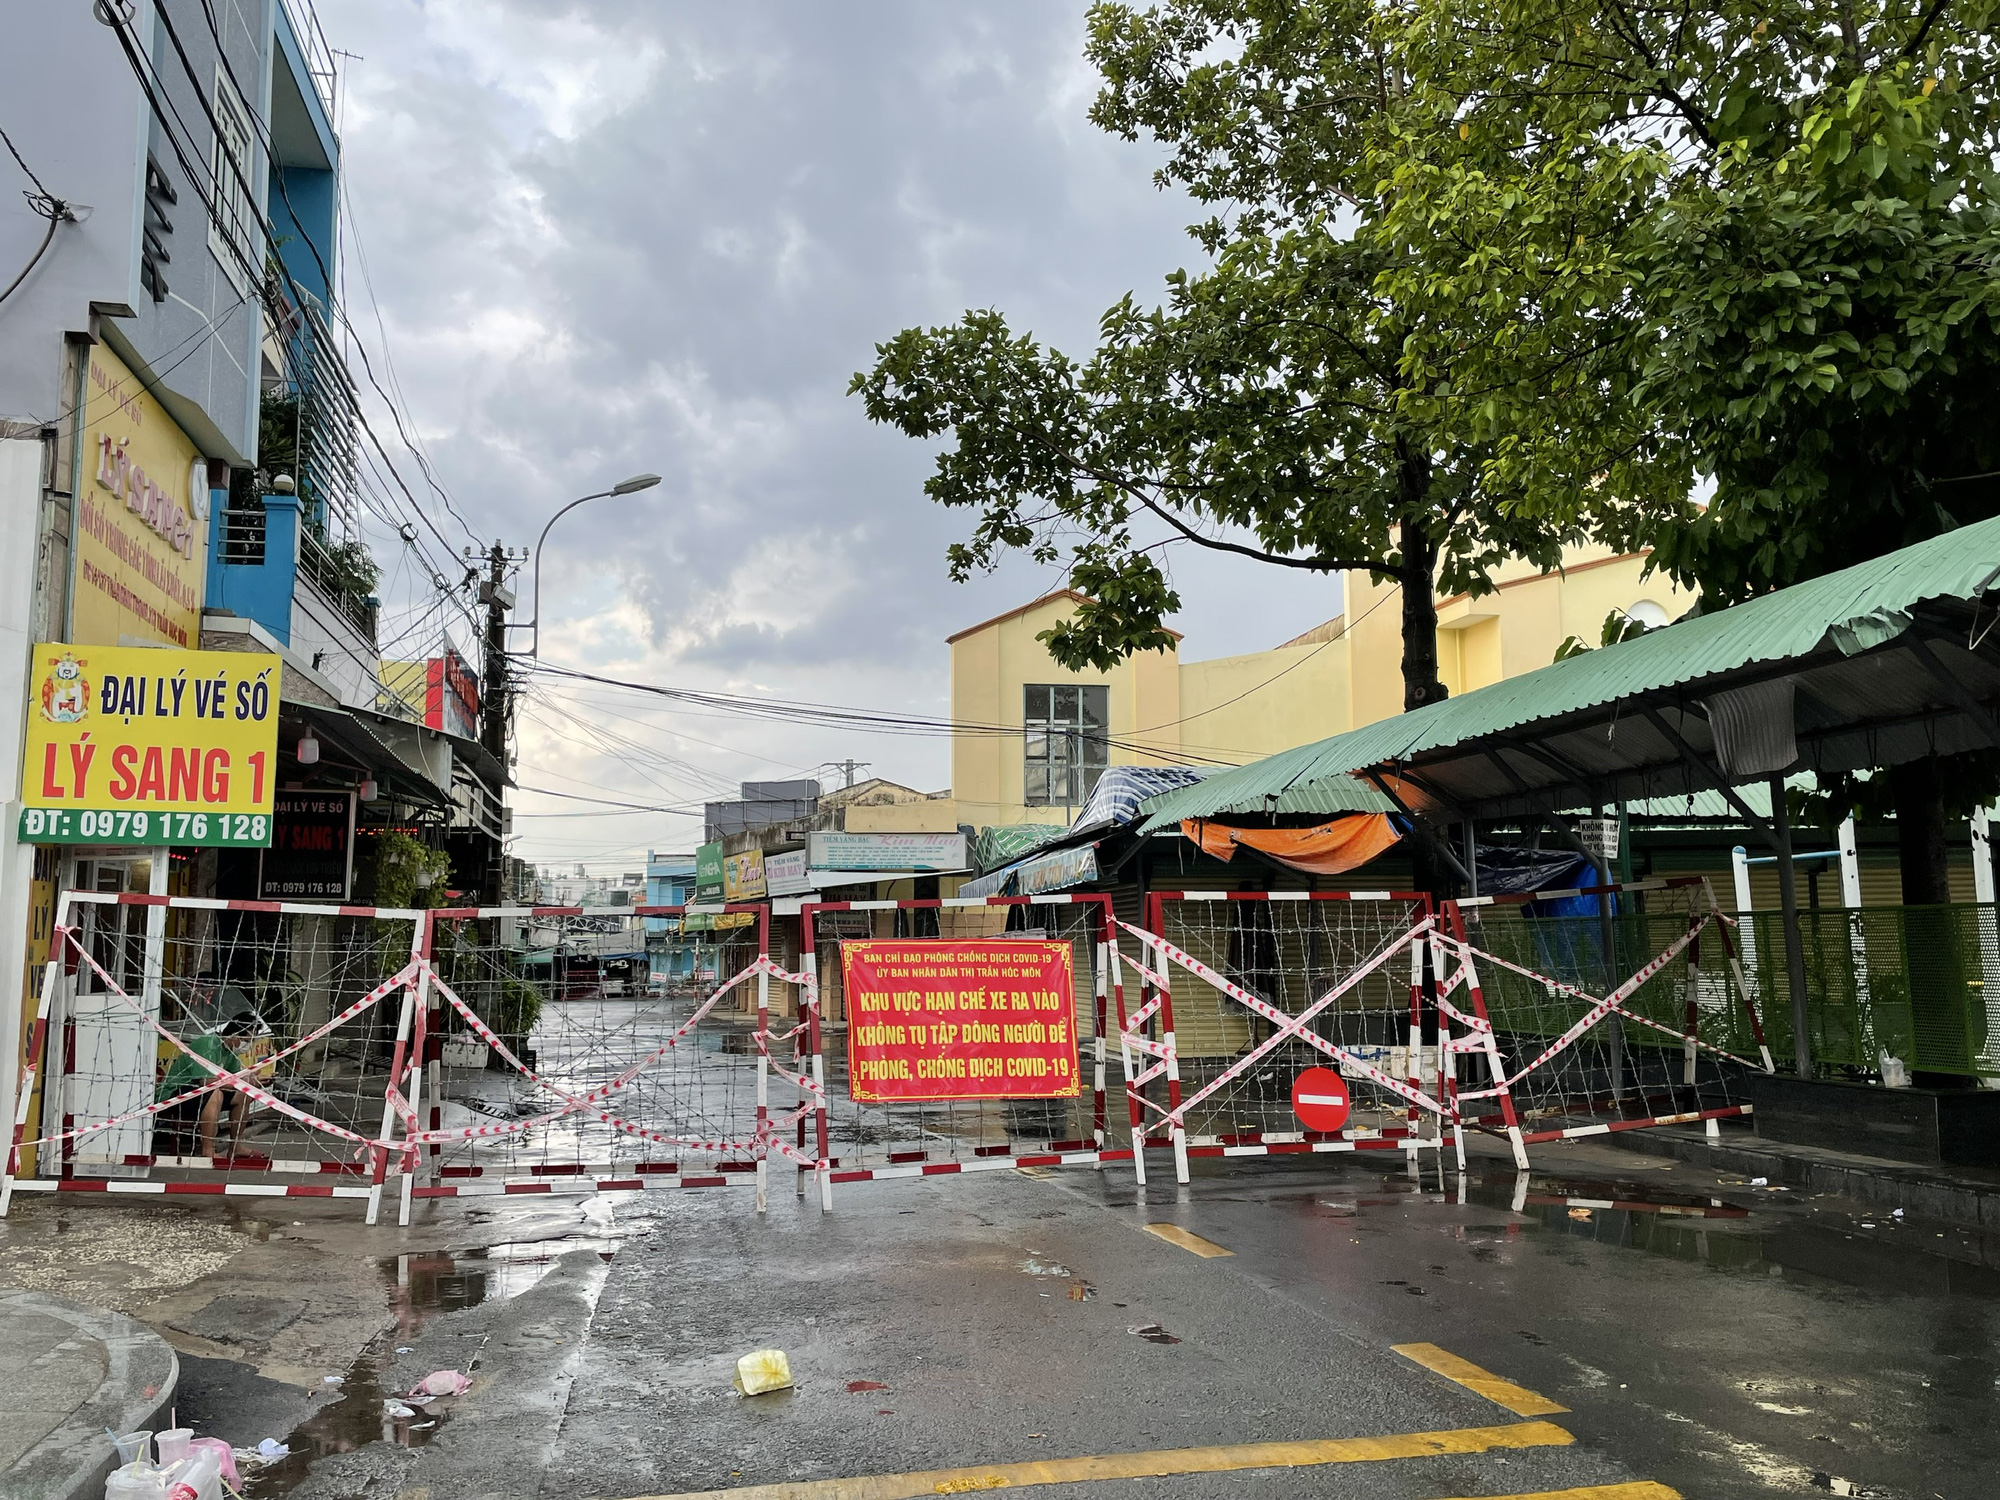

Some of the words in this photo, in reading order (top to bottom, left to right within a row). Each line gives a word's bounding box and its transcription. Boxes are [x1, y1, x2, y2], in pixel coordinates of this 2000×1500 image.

[97, 432, 130, 500] LÝ
[126, 464, 186, 552] SANG
[100, 675, 146, 725] ĐẠI
[155, 669, 188, 718] LÝ
[195, 671, 226, 720] VÉ
[235, 668, 273, 721] SỐ
[42, 732, 96, 799] LÝ
[109, 744, 231, 804] SANG
[248, 751, 266, 804] 1
[294, 799, 308, 813] LÝ
[311, 799, 326, 813] VÉ
[328, 798, 344, 814] SỐ
[25, 809, 70, 837] ĐT:
[80, 811, 149, 838] 0979
[159, 812, 208, 840] 176
[218, 814, 267, 841] 128
[292, 825, 332, 851] SANG
[840, 836, 857, 844] VÀNG
[34, 847, 53, 891] ĐẠI
[786, 855, 800, 864] VÀNG
[788, 864, 802, 876] MAY
[264, 881, 281, 893] ĐT:
[282, 881, 305, 894] 0979
[307, 882, 324, 894] 176
[326, 882, 342, 894] 128
[34, 898, 48, 940] LÝ
[864, 954, 882, 963] BAN
[885, 951, 900, 963] CHỈ
[903, 954, 921, 966] ĐẠO
[924, 951, 954, 963] PHÒNG
[957, 950, 987, 963] CHỐNG
[990, 953, 1011, 965] DỊCH
[1013, 954, 1051, 963] COVID-19
[877, 967, 889, 978] ỦY
[891, 969, 909, 978] BAN
[912, 967, 937, 978] NHÂN
[940, 967, 958, 978] DÂN
[961, 968, 974, 979] THỊ
[977, 966, 999, 978] TRẤN
[1002, 966, 1019, 978] HÓC
[1022, 966, 1041, 978] MÔN
[860, 992, 889, 1012] KHU
[893, 990, 921, 1015] VỰC
[926, 991, 955, 1015] HẠN
[959, 986, 986, 1010] CHẾ
[990, 991, 1007, 1010] XE
[1011, 991, 1030, 1010] RA
[1033, 988, 1059, 1010] VÀO
[857, 1021, 905, 1046] KHÔNG
[909, 1025, 926, 1049] TỤ
[930, 1021, 958, 1048] TẬP
[962, 1020, 1000, 1044] ĐÔNG
[1004, 1023, 1046, 1044] NGƯỜI
[1049, 1017, 1068, 1043] ĐỂ
[860, 1057, 914, 1081] PHÒNG,
[918, 1052, 965, 1078] CHỐNG
[970, 1057, 1004, 1082] DỊCH
[1007, 1057, 1068, 1077] COVID-19
